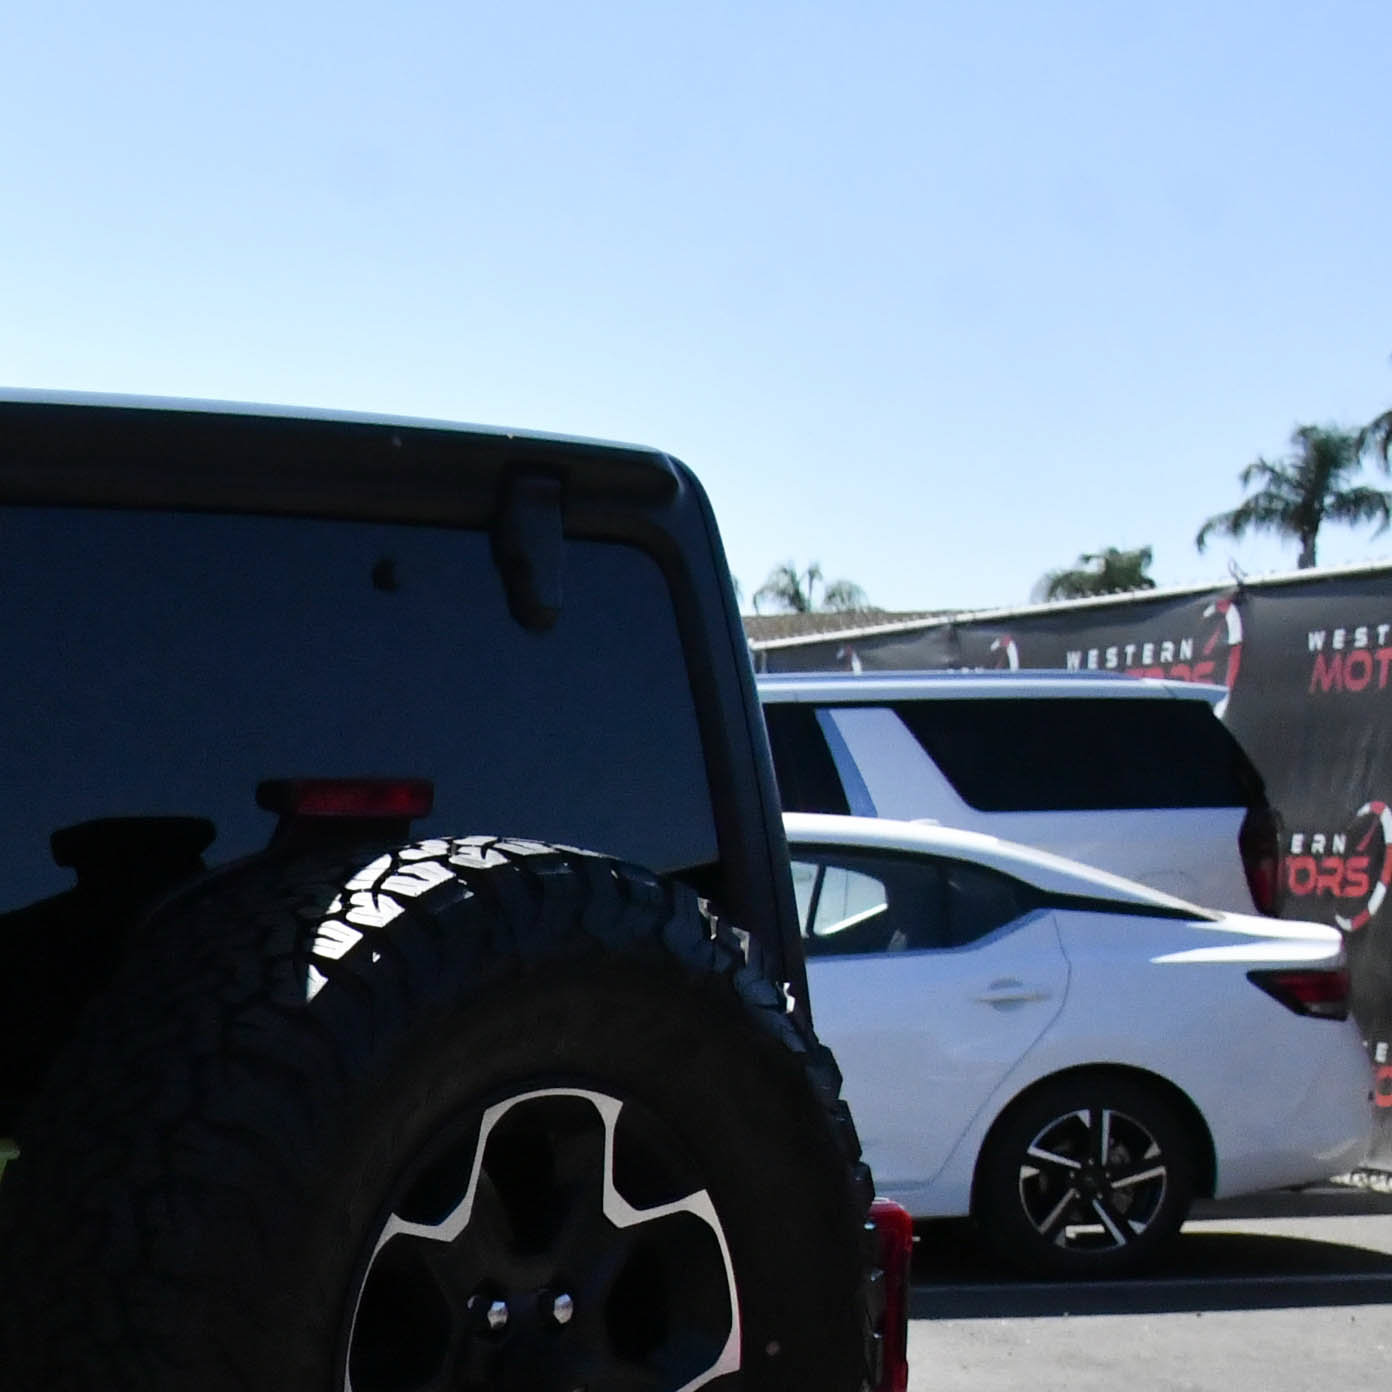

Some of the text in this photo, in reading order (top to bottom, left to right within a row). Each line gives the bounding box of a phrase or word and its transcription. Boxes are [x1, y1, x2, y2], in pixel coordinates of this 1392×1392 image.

[1308, 624, 1390, 651] WEST
[1066, 638, 1194, 672] WESTERN
[1285, 856, 1370, 897] ORS
